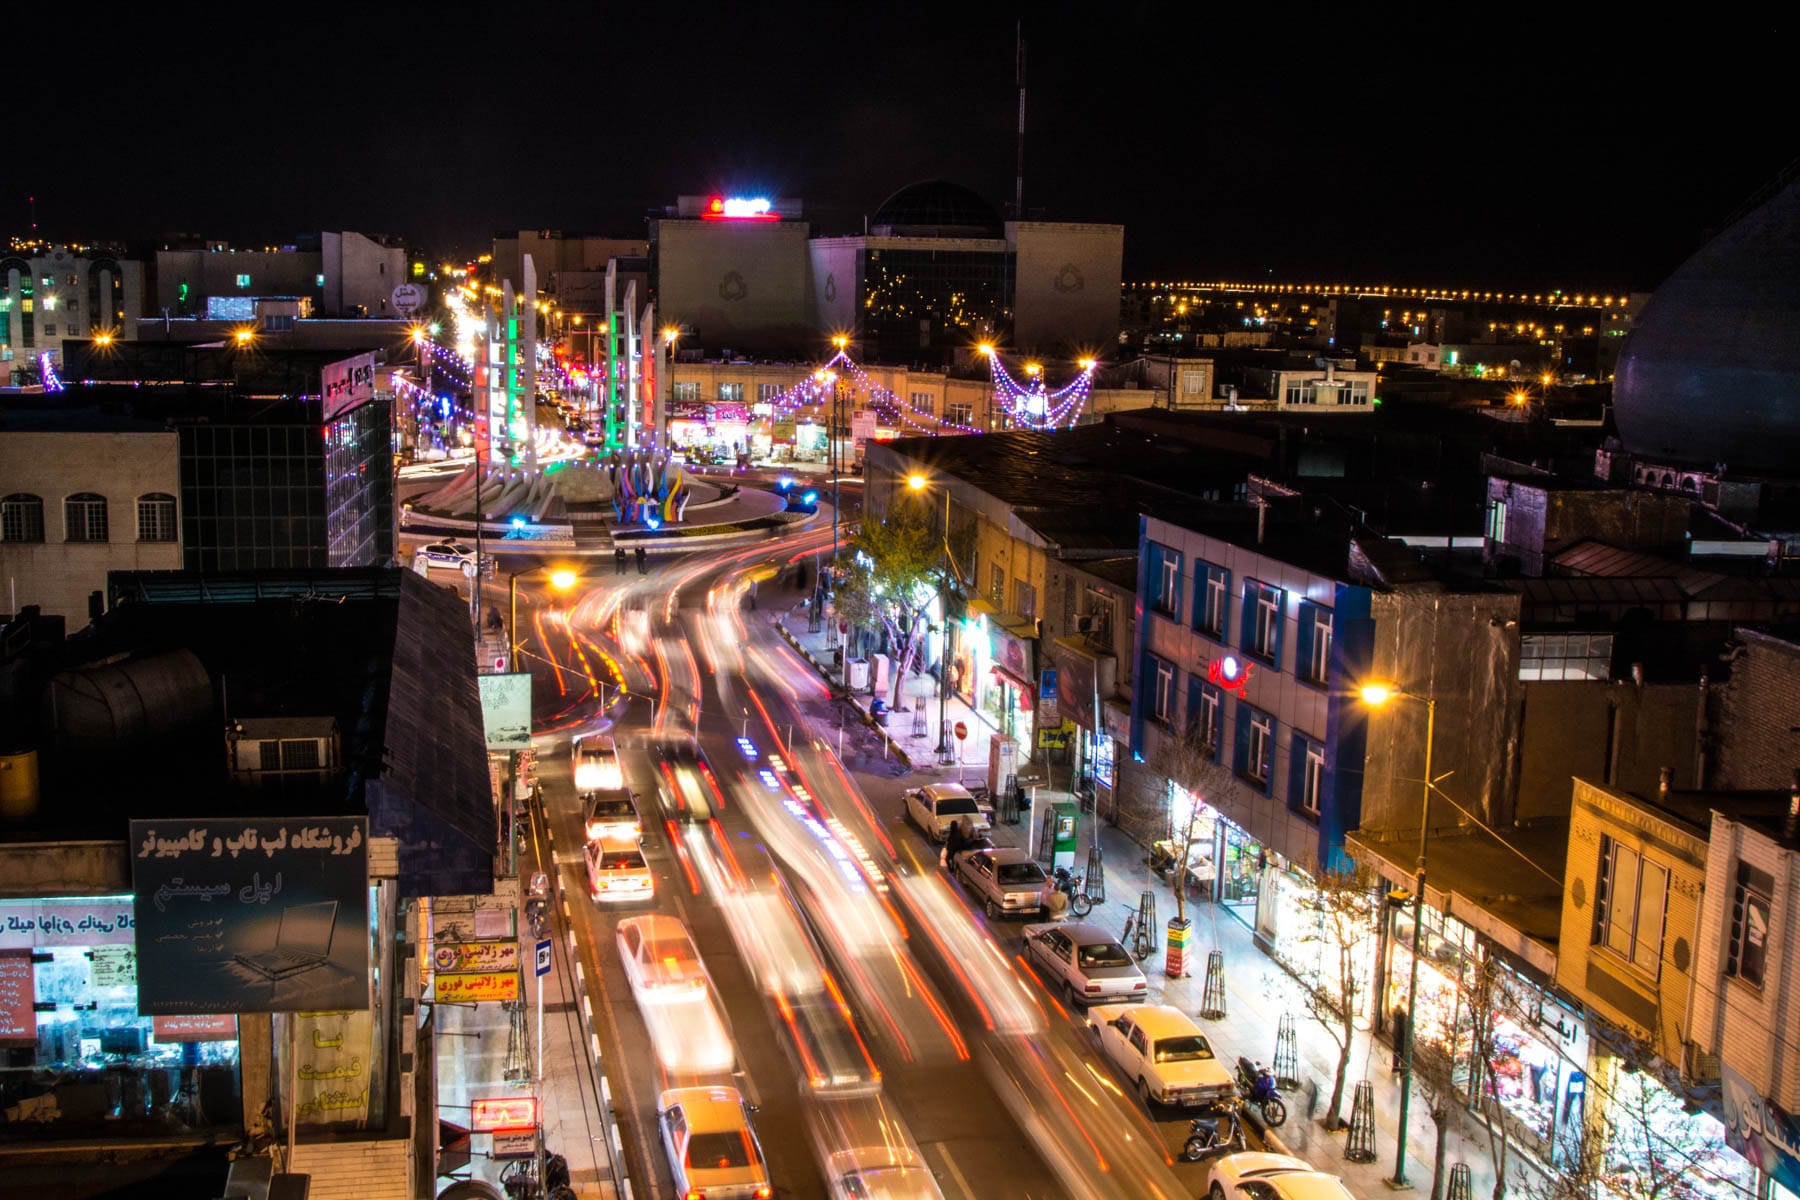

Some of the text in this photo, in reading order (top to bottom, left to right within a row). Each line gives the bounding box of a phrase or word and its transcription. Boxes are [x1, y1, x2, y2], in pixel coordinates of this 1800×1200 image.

[395, 287, 416, 298] هتل
[138, 825, 362, 858] فروشگاه لپ تاپ و کامپیوتر
[154, 877, 231, 912] سیستم
[438, 976, 463, 992] فوری
[313, 1029, 344, 1052] با
[298, 1056, 362, 1083] قیمت
